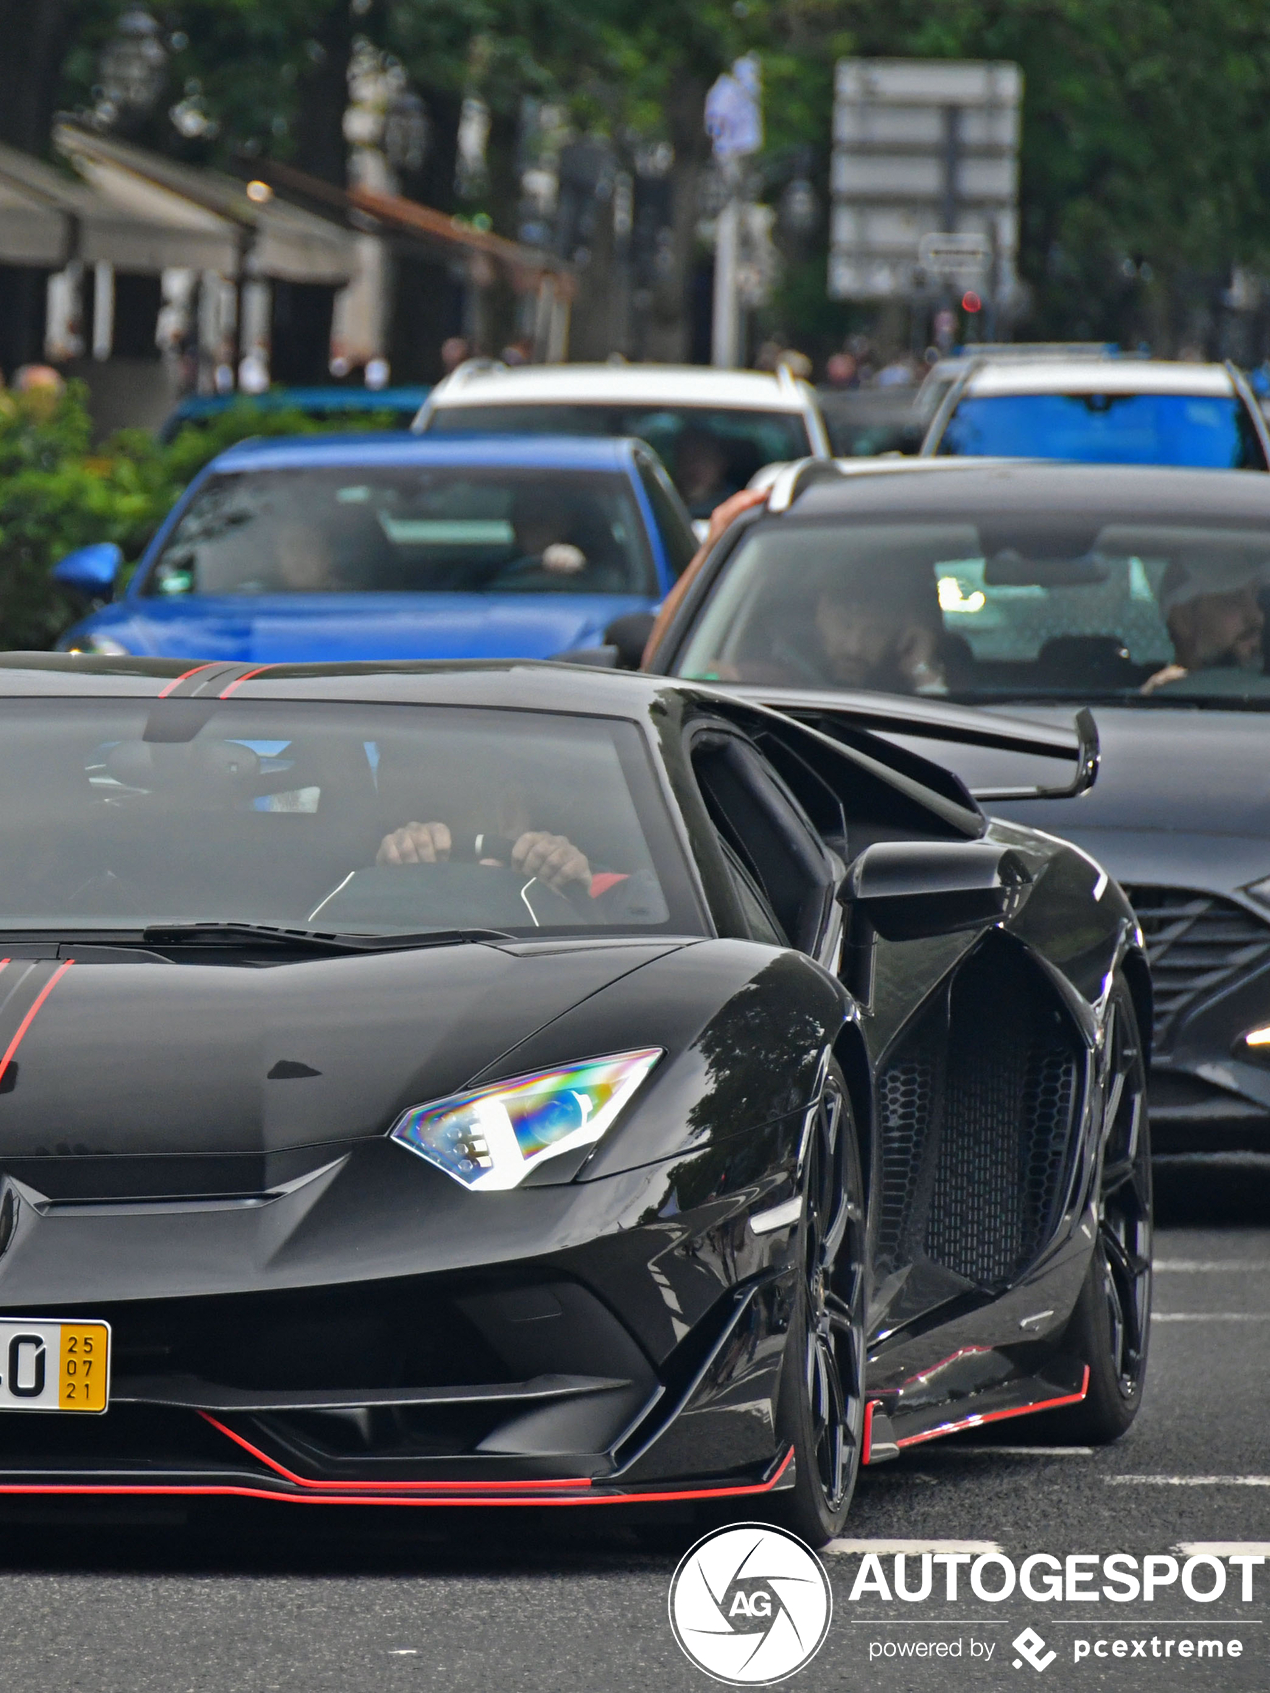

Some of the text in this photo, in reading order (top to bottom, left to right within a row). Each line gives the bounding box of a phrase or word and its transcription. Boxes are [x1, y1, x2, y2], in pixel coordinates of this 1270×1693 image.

[67, 1335, 94, 1354] 25
[66, 1358, 93, 1377] 07
[65, 1381, 90, 1400] 21
